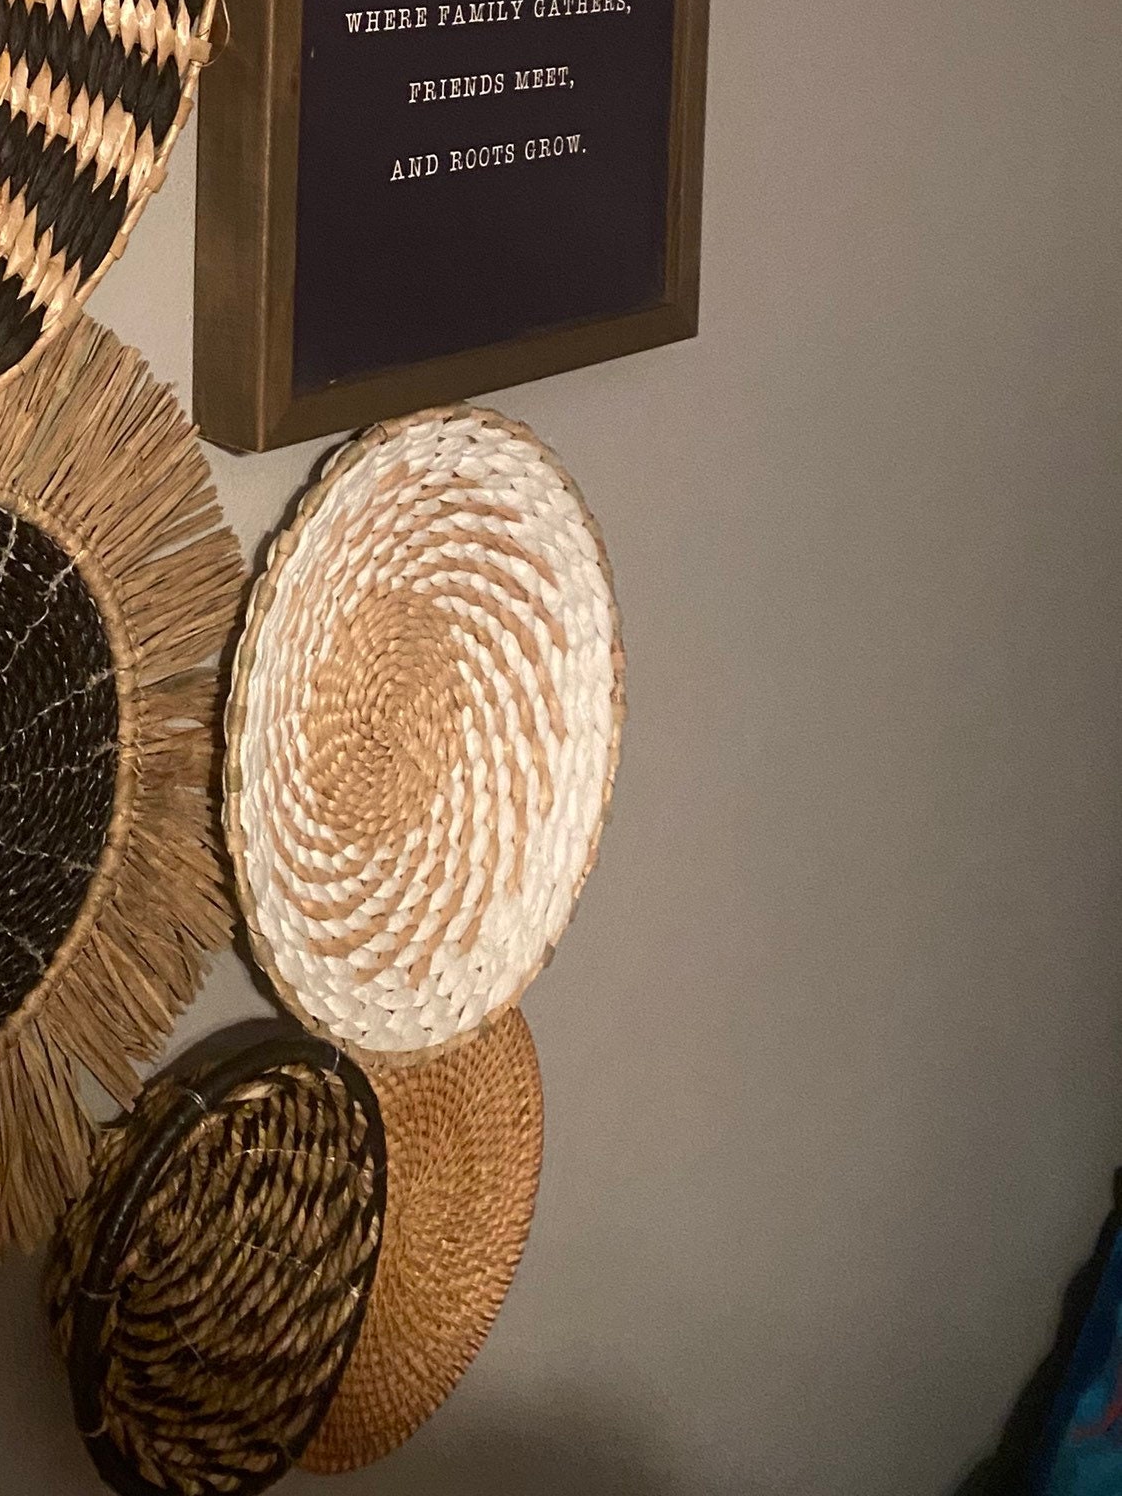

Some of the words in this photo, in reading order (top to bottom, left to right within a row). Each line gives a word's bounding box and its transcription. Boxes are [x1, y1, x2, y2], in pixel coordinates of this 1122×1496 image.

[345, 6, 428, 34] WHERE
[437, 0, 524, 26] FAMILY
[408, 73, 505, 104] FRIENDS
[514, 66, 575, 90] MEET,
[389, 153, 439, 182] AND
[449, 143, 515, 172] ROOTS
[524, 134, 587, 161] GROW.
